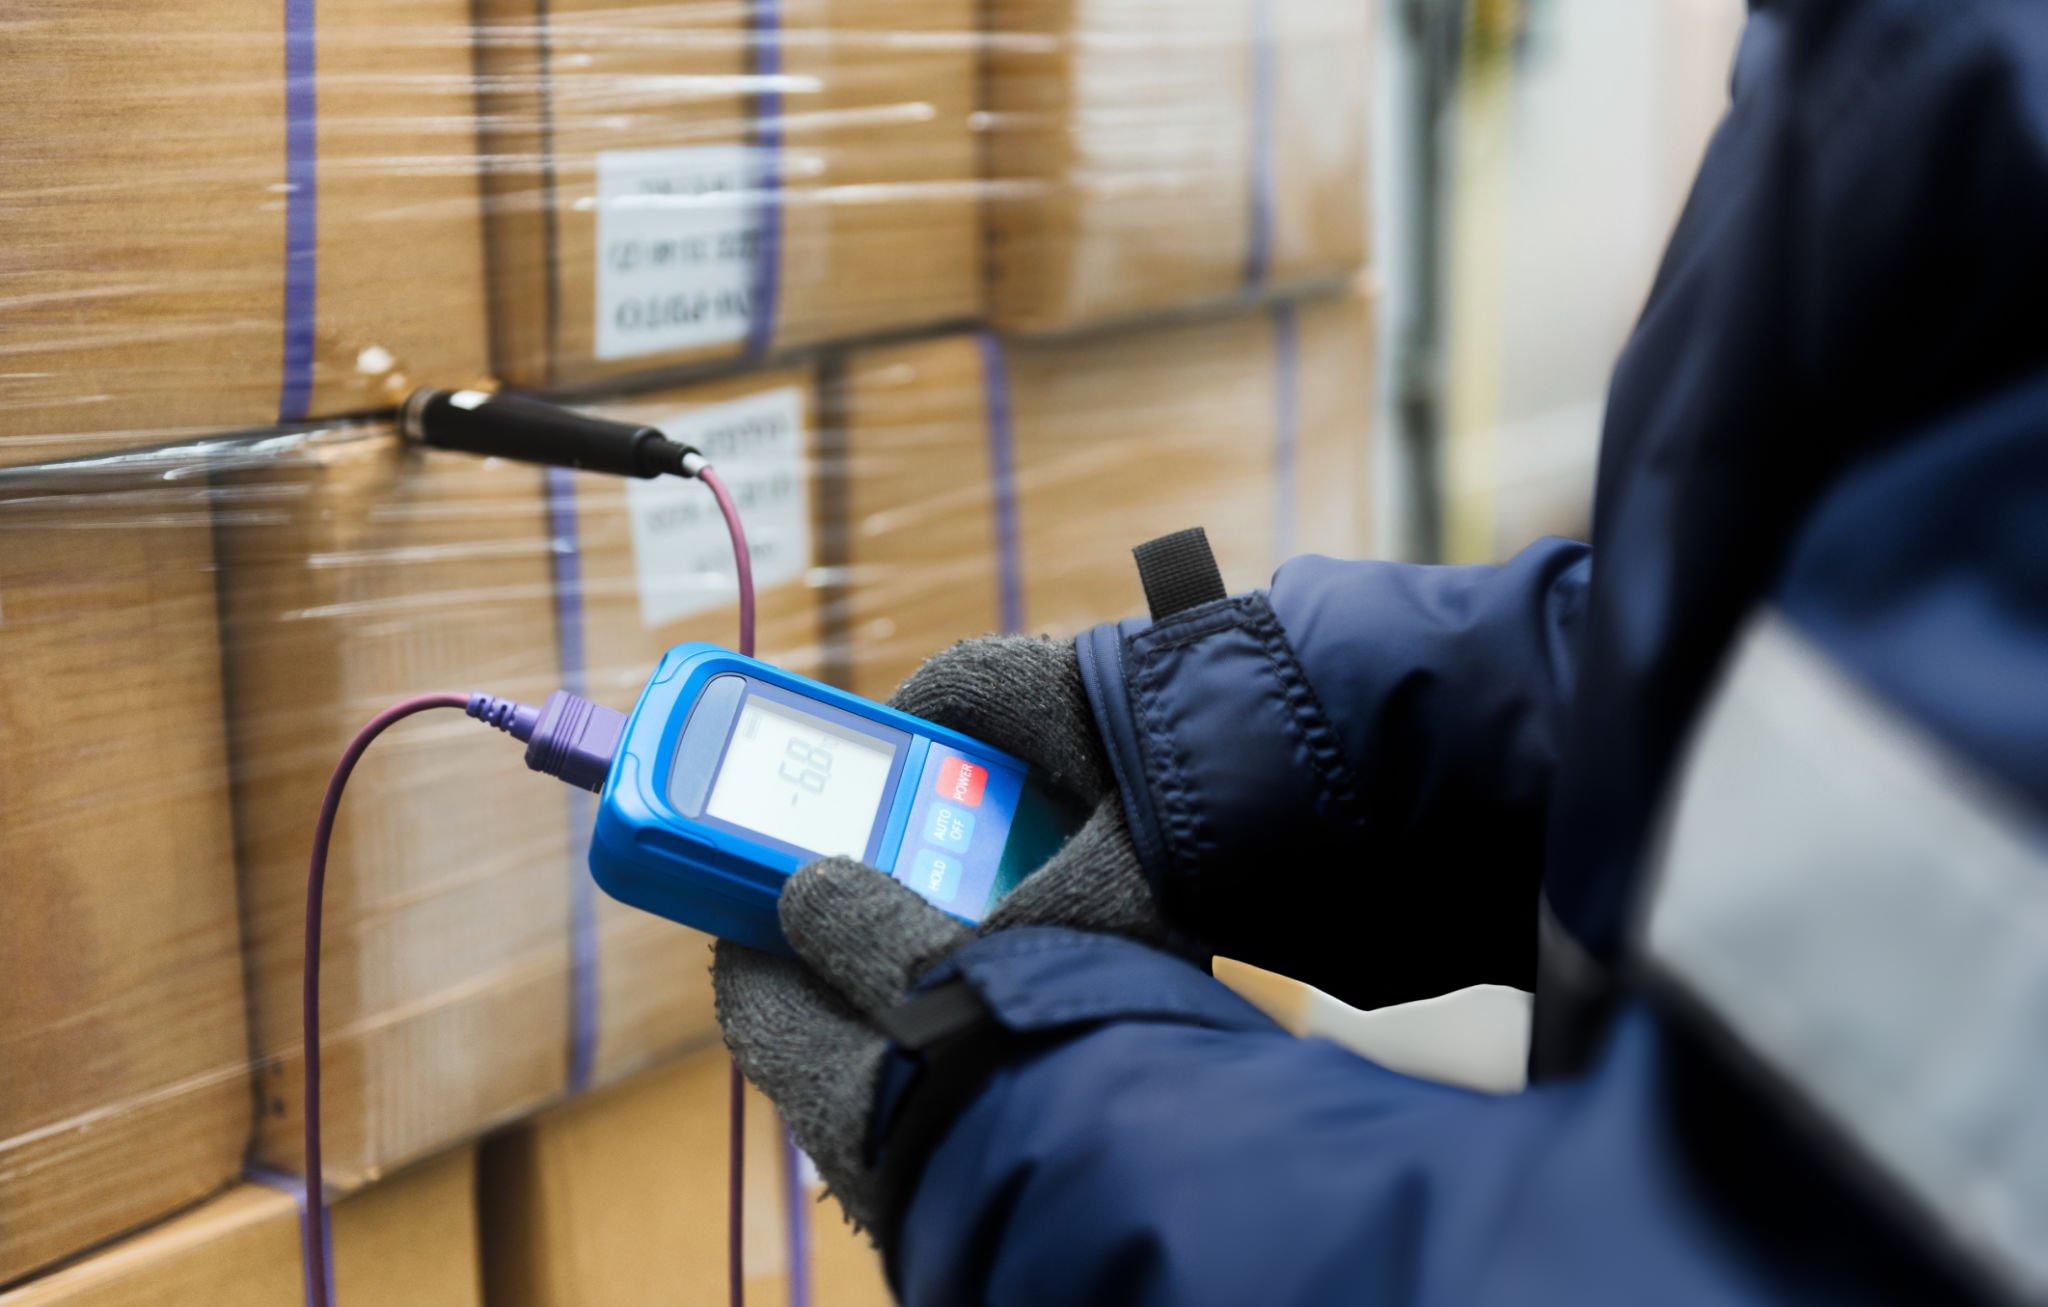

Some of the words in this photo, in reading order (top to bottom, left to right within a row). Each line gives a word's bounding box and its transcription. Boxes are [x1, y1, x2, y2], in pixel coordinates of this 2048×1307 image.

[953, 763, 973, 801] POWER
[933, 808, 951, 841] AUTO
[950, 818, 965, 841] OFF
[928, 860, 946, 892] HOLD
